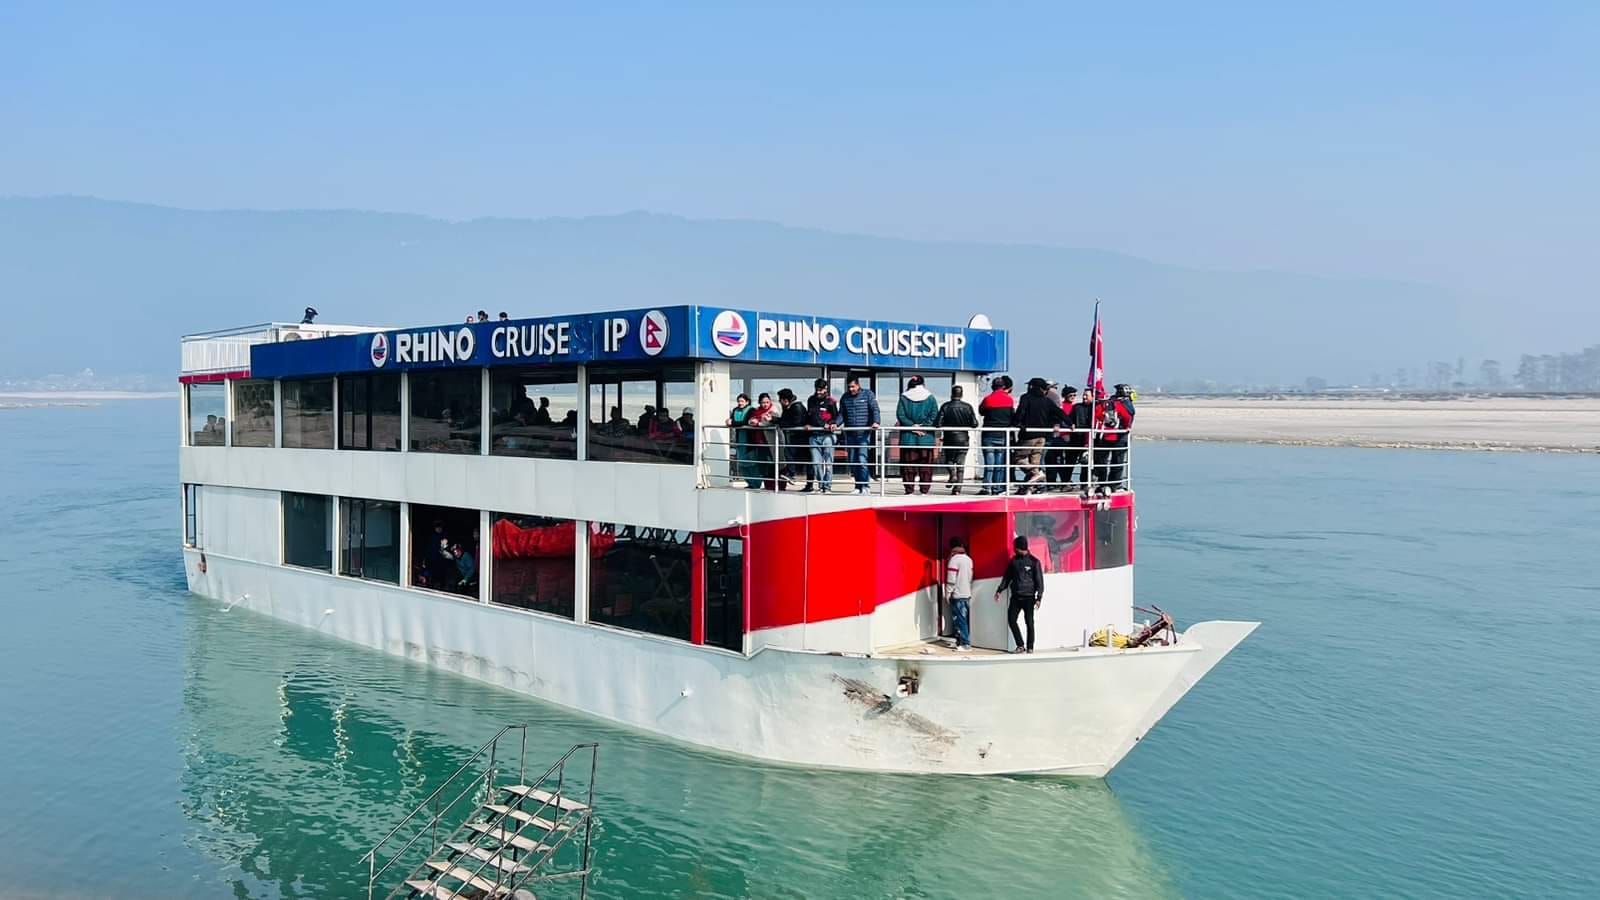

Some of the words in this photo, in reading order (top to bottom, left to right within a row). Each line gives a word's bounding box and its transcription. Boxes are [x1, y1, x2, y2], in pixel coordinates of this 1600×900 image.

[396, 327, 474, 363] RHINO
[758, 319, 840, 354] RHINO
[846, 326, 966, 358] CRUISESHIP
